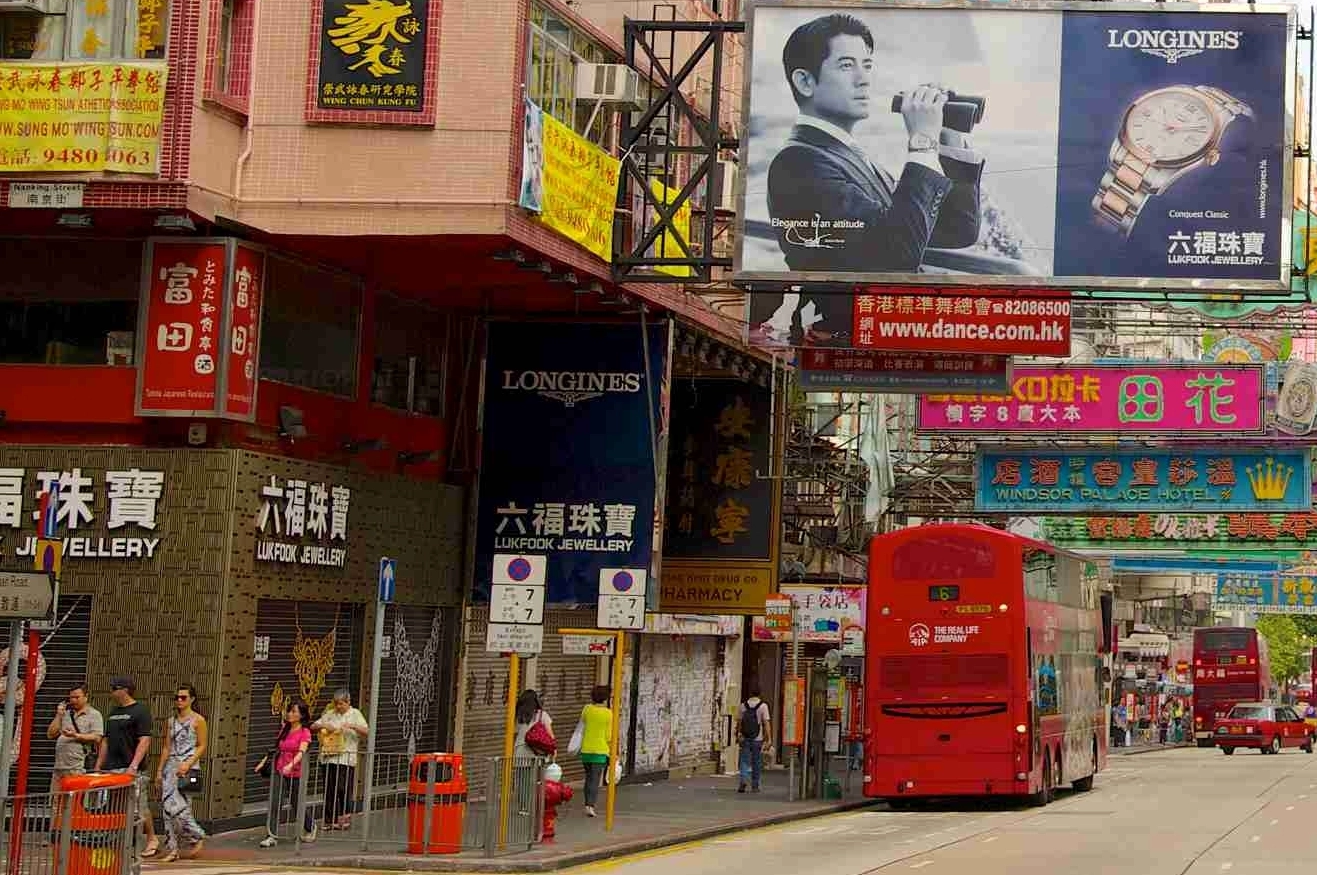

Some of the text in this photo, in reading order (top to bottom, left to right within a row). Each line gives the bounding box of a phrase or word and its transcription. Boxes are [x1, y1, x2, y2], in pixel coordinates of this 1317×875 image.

[1108, 29, 1240, 49] LONGINES
[323, 97, 346, 105] WING
[405, 98, 416, 106] FU
[43, 148, 98, 163] 9480
[1168, 209, 1229, 220] Conquest Classic
[772, 218, 808, 229] Elegance
[820, 220, 831, 228] an
[833, 219, 865, 229] attitude
[1168, 231, 1265, 255] 六福珠寶
[1168, 255, 1264, 265] LUKFOOK JEWELLERY
[157, 262, 199, 352] 富田
[858, 295, 1070, 316] 香港標準舞總會 82086500
[879, 318, 1064, 341] www.dance.com.hk
[501, 370, 641, 393] LONGINES
[997, 488, 1216, 501] WINDSOR PALACE HOTEL
[255, 475, 351, 541] 六福珠寶
[495, 501, 637, 538] 六福珠寶
[16, 537, 160, 557] JELLERY
[494, 537, 634, 552] LUKFOOK JEWELLERY
[257, 542, 347, 567] LUKFOOK JEWELLERY
[526, 588, 535, 601] 7
[940, 586, 950, 601] 6
[629, 598, 637, 609] 7
[525, 608, 534, 621] 7
[628, 615, 636, 627] 7
[933, 625, 980, 635] THE REAL LIFE
[933, 634, 967, 643] COMPANY
